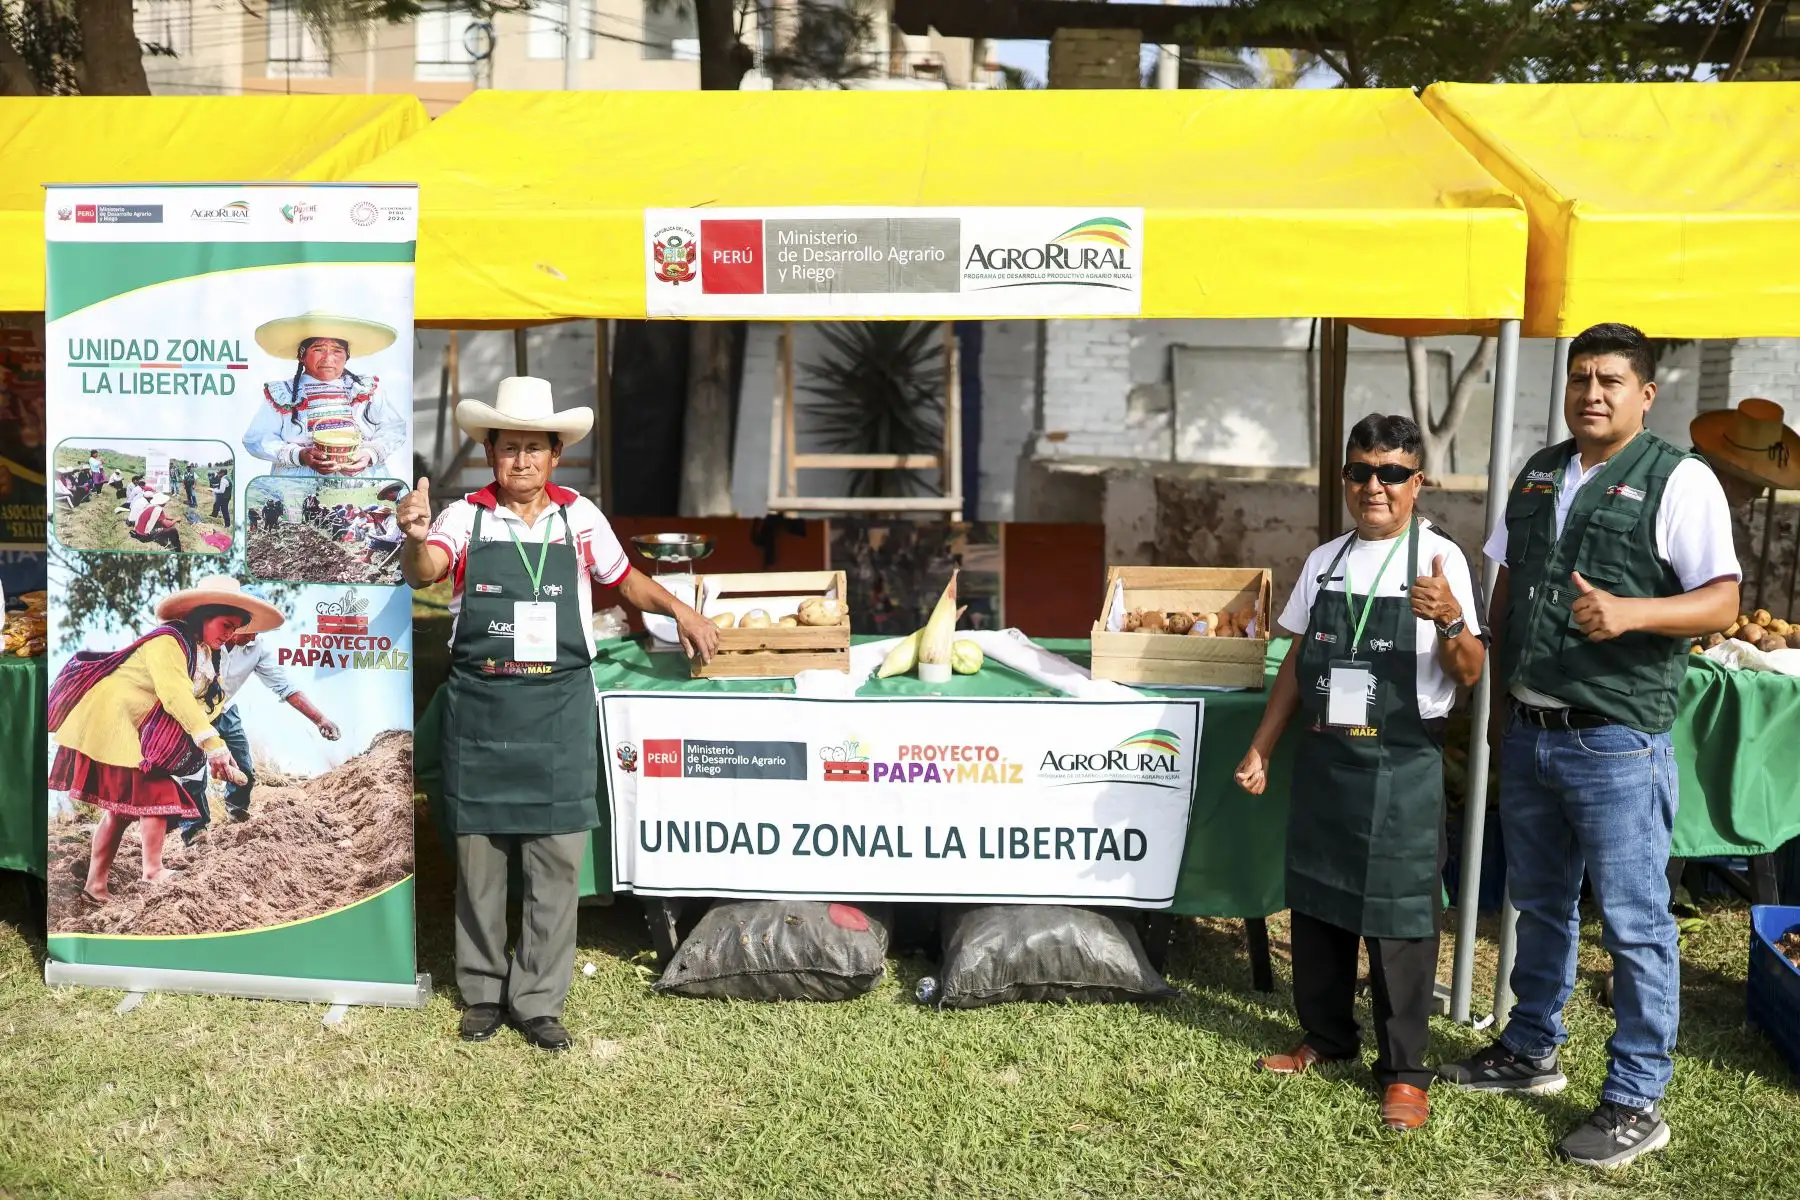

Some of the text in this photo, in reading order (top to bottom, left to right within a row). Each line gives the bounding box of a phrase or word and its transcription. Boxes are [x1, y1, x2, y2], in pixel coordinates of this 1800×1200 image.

[778, 230, 858, 245] Ministerio
[712, 246, 753, 264] PERÚ
[778, 246, 945, 265] de Desarrollo Agrario
[778, 265, 835, 283] y Riego
[68, 338, 248, 362] UNIDAD ZONAL
[82, 371, 236, 396] LA LIBERTAD
[300, 633, 392, 651] PROYECTO
[278, 647, 409, 671] PAPA Y MAÍZ
[527, 664, 552, 674] MAÍZ
[1350, 726, 1378, 737] MAÍZ
[647, 750, 678, 764] PERÚ
[687, 744, 735, 755] Ministerio
[898, 744, 1000, 762] PROYECTO
[687, 755, 787, 767] de Desarrollo Agrario
[687, 764, 722, 775] y Riego
[873, 757, 1024, 784] PAPA Y MAÍZ
[640, 820, 1148, 862] UNIDAD ZONAL LA LIBERTAD
